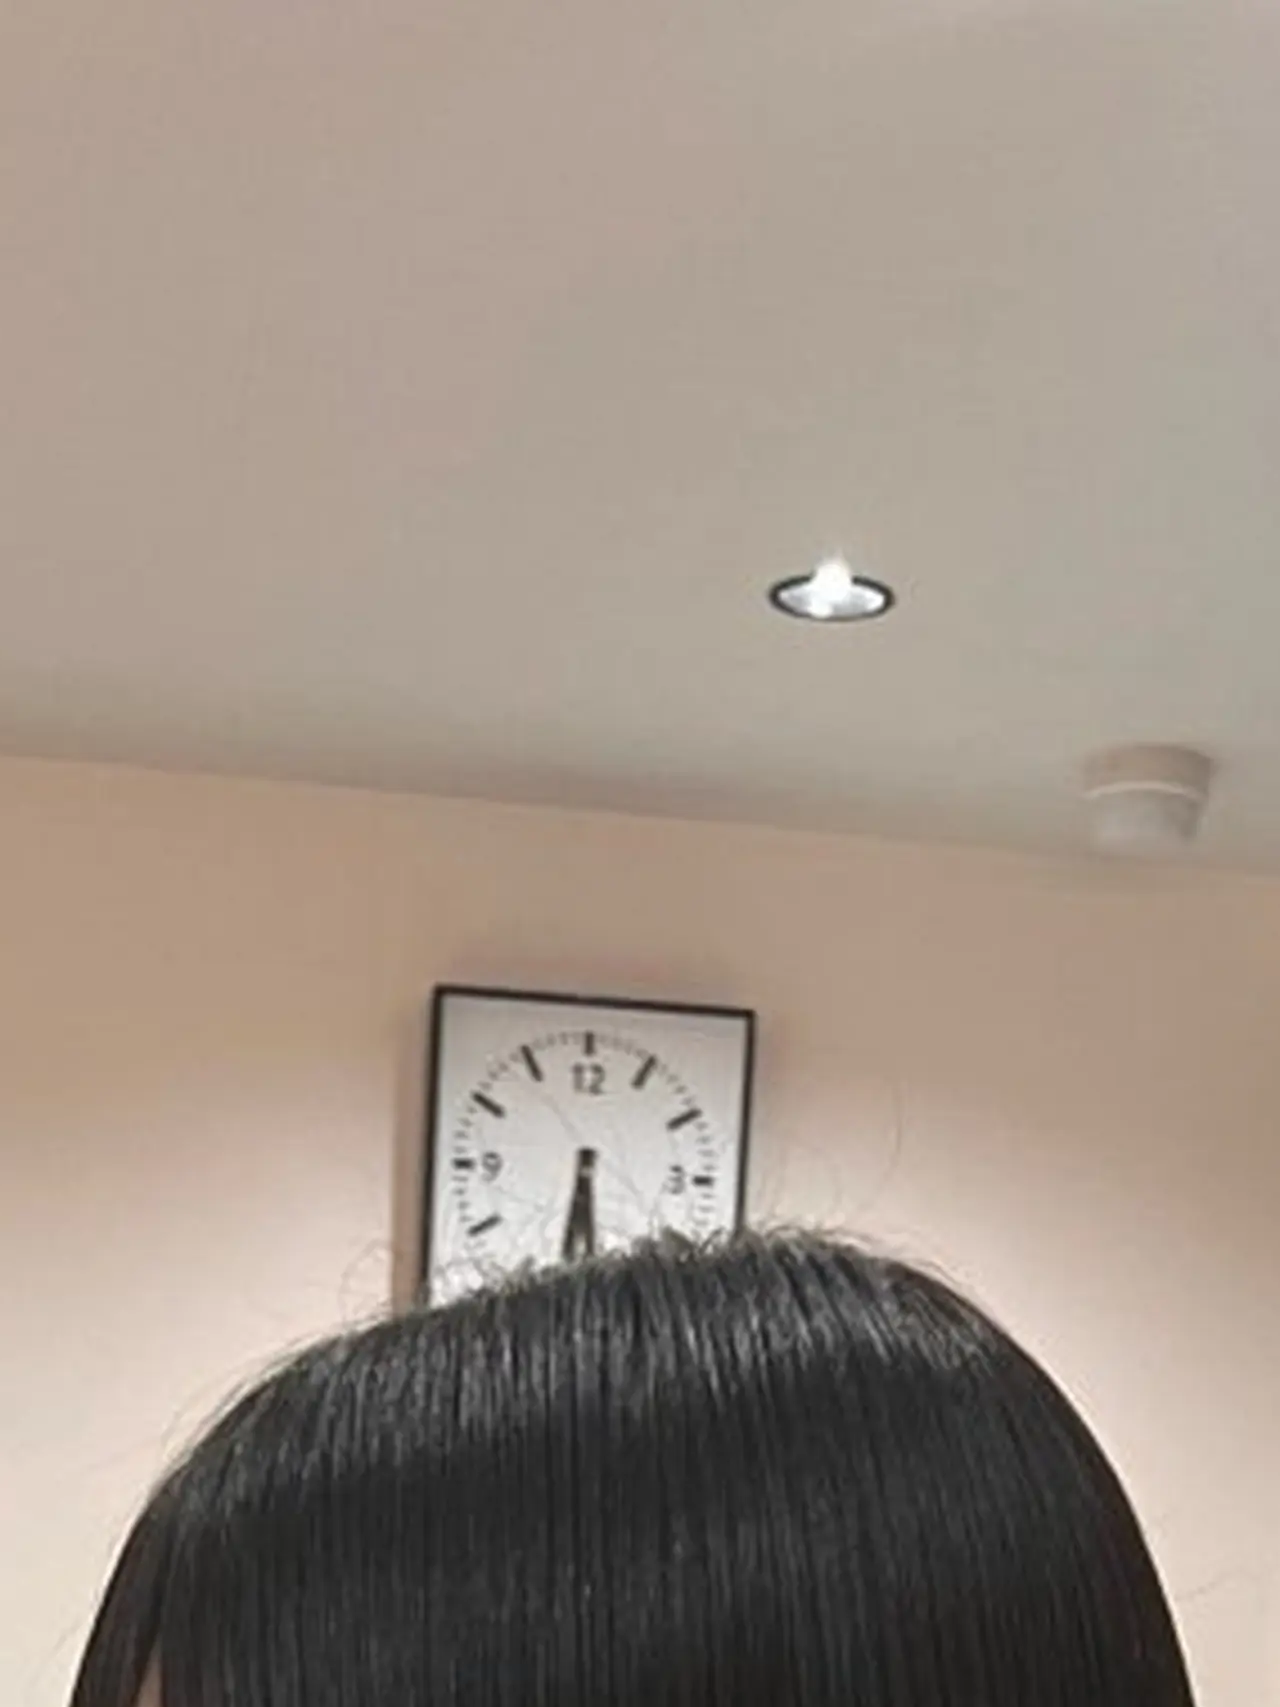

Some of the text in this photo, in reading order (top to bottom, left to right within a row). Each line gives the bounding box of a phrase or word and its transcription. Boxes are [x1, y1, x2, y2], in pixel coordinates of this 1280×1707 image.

[572, 1063, 606, 1095] 12
[481, 1151, 503, 1182] 9
[668, 1164, 685, 1195] 3
